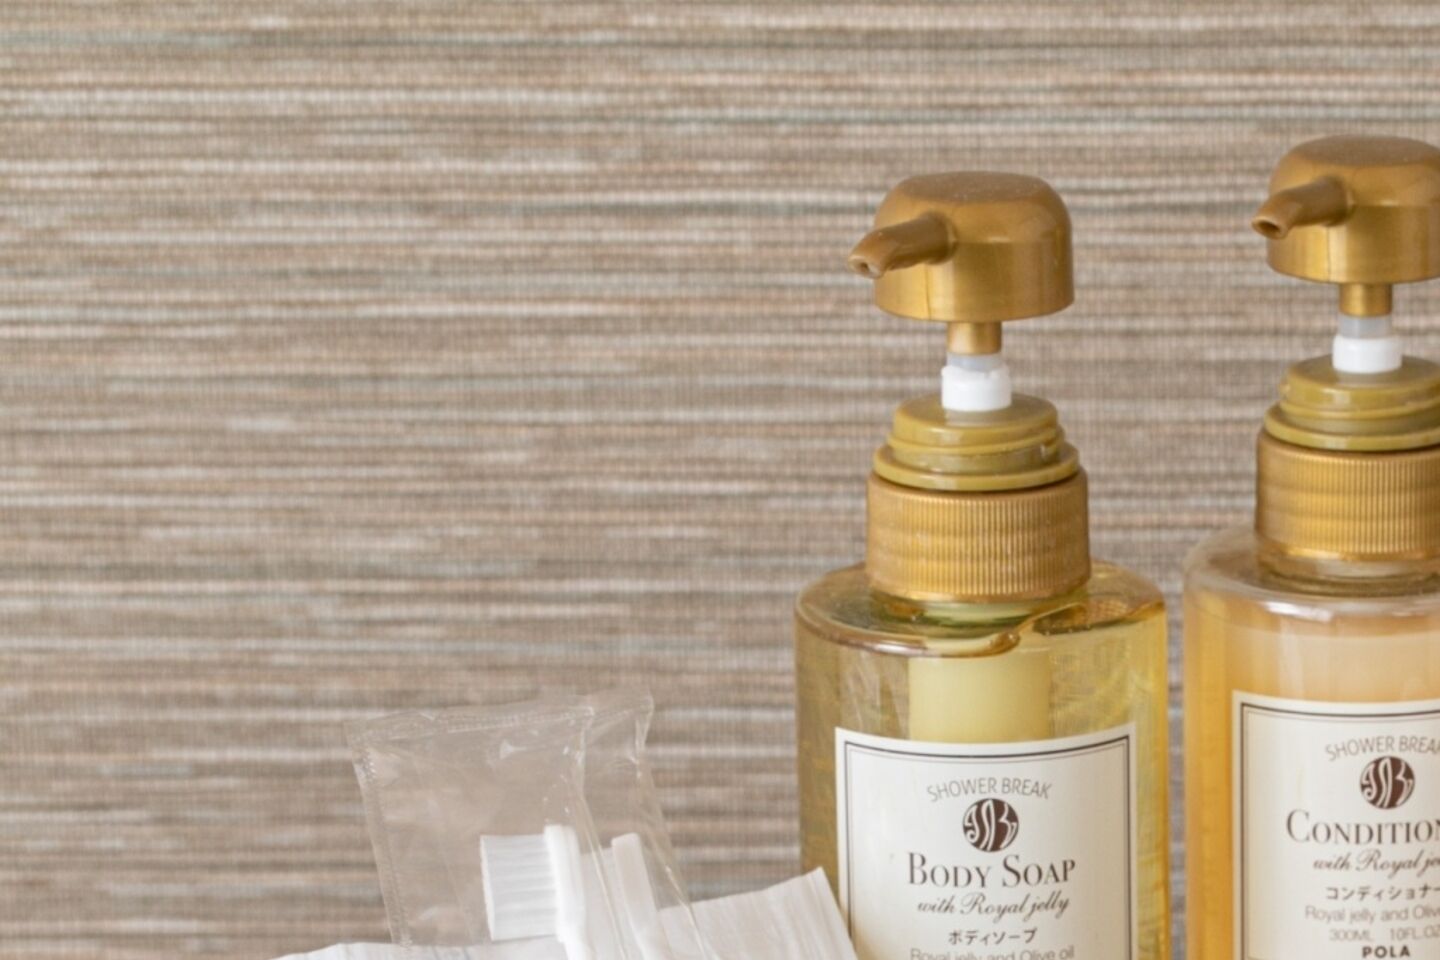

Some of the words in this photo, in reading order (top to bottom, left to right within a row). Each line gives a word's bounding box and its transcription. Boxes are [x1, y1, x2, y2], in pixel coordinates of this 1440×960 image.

[1325, 736, 1395, 762] SHOWER
[927, 777, 997, 802] SHOWER
[1002, 777, 1052, 800] BREAK
[907, 852, 991, 888] BODY
[1002, 854, 1076, 888] SOAP
[1313, 852, 1351, 872] with
[1355, 849, 1420, 879] Royal
[917, 893, 955, 914] with
[959, 892, 1026, 924] Royal
[1023, 890, 1070, 922] jelly
[1305, 905, 1346, 924] Royal
[1349, 907, 1376, 924] jelly
[1380, 908, 1409, 921] and
[948, 927, 1038, 946] ボディソープ
[1058, 945, 1075, 960] oil
[1362, 945, 1410, 959] POLA
